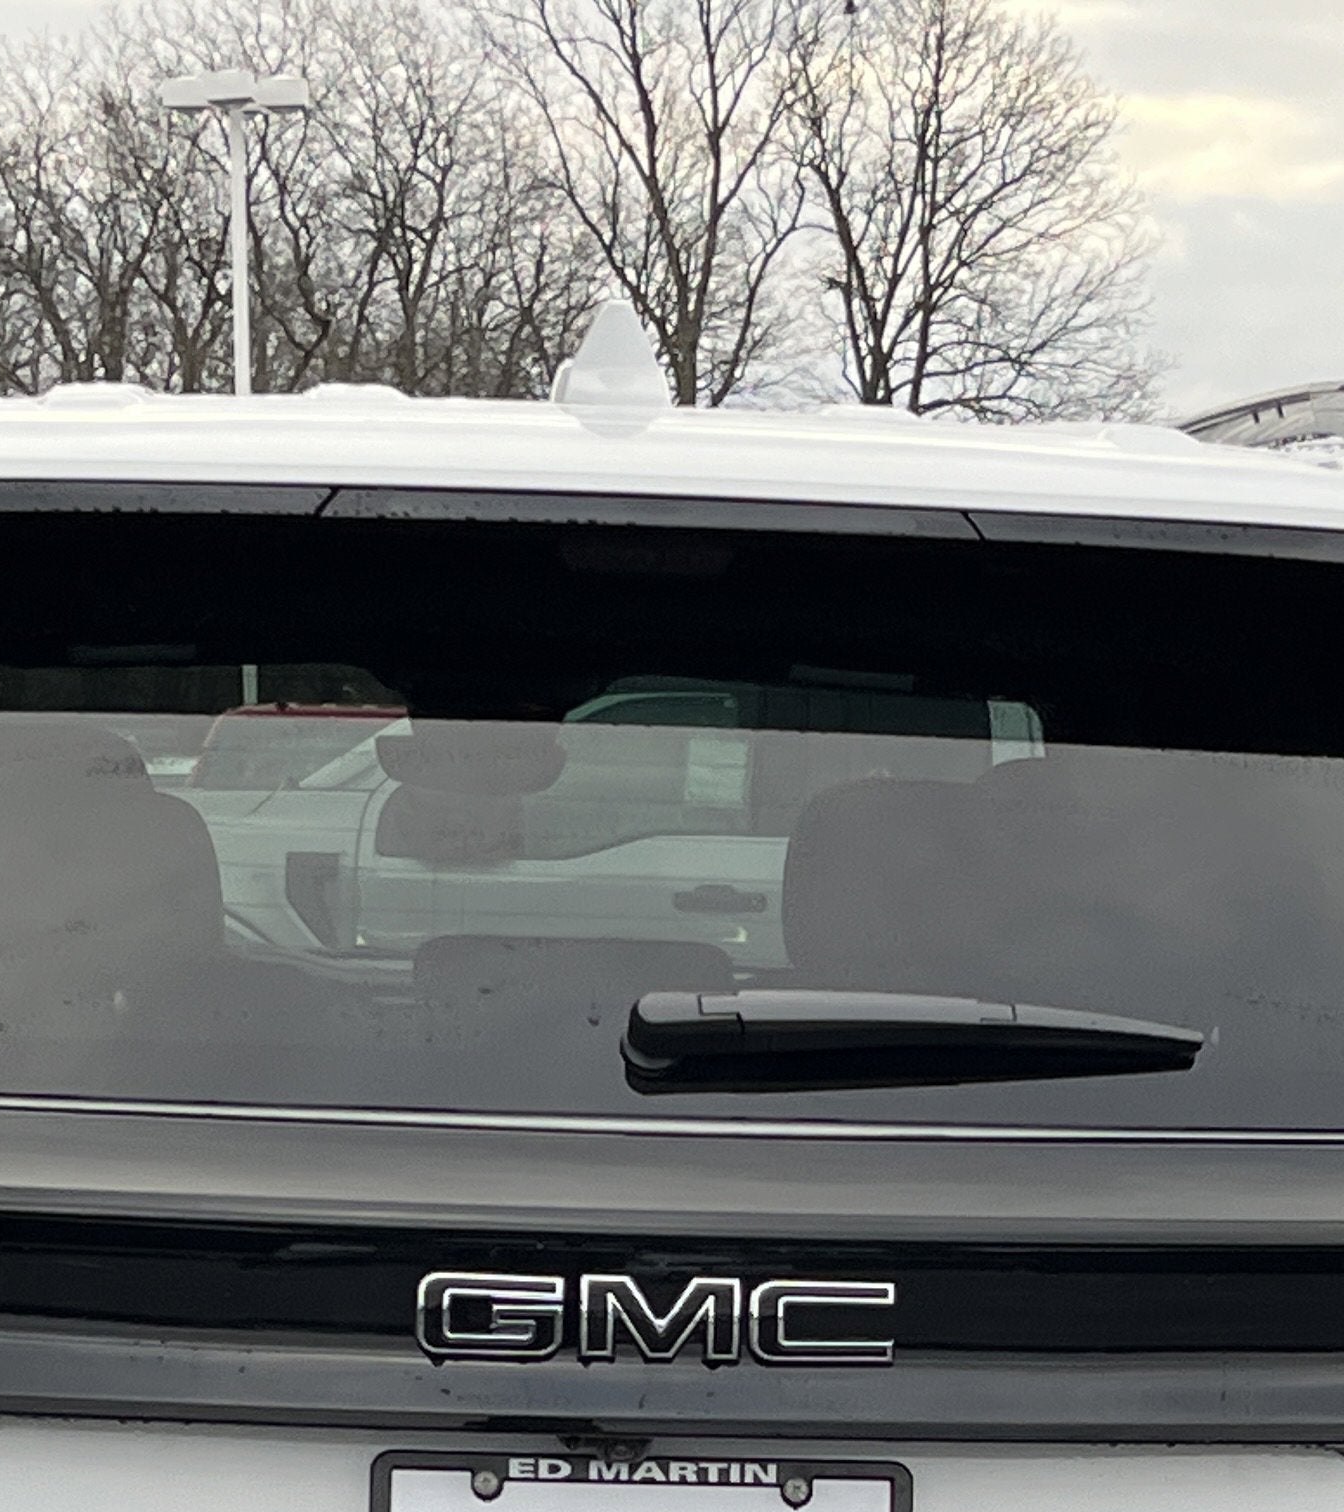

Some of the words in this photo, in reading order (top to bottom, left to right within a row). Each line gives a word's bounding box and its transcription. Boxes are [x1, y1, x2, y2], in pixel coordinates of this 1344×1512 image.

[415, 1271, 896, 1365] GMC
[508, 1457, 573, 1480] ED
[587, 1459, 778, 1484] MARTIN
